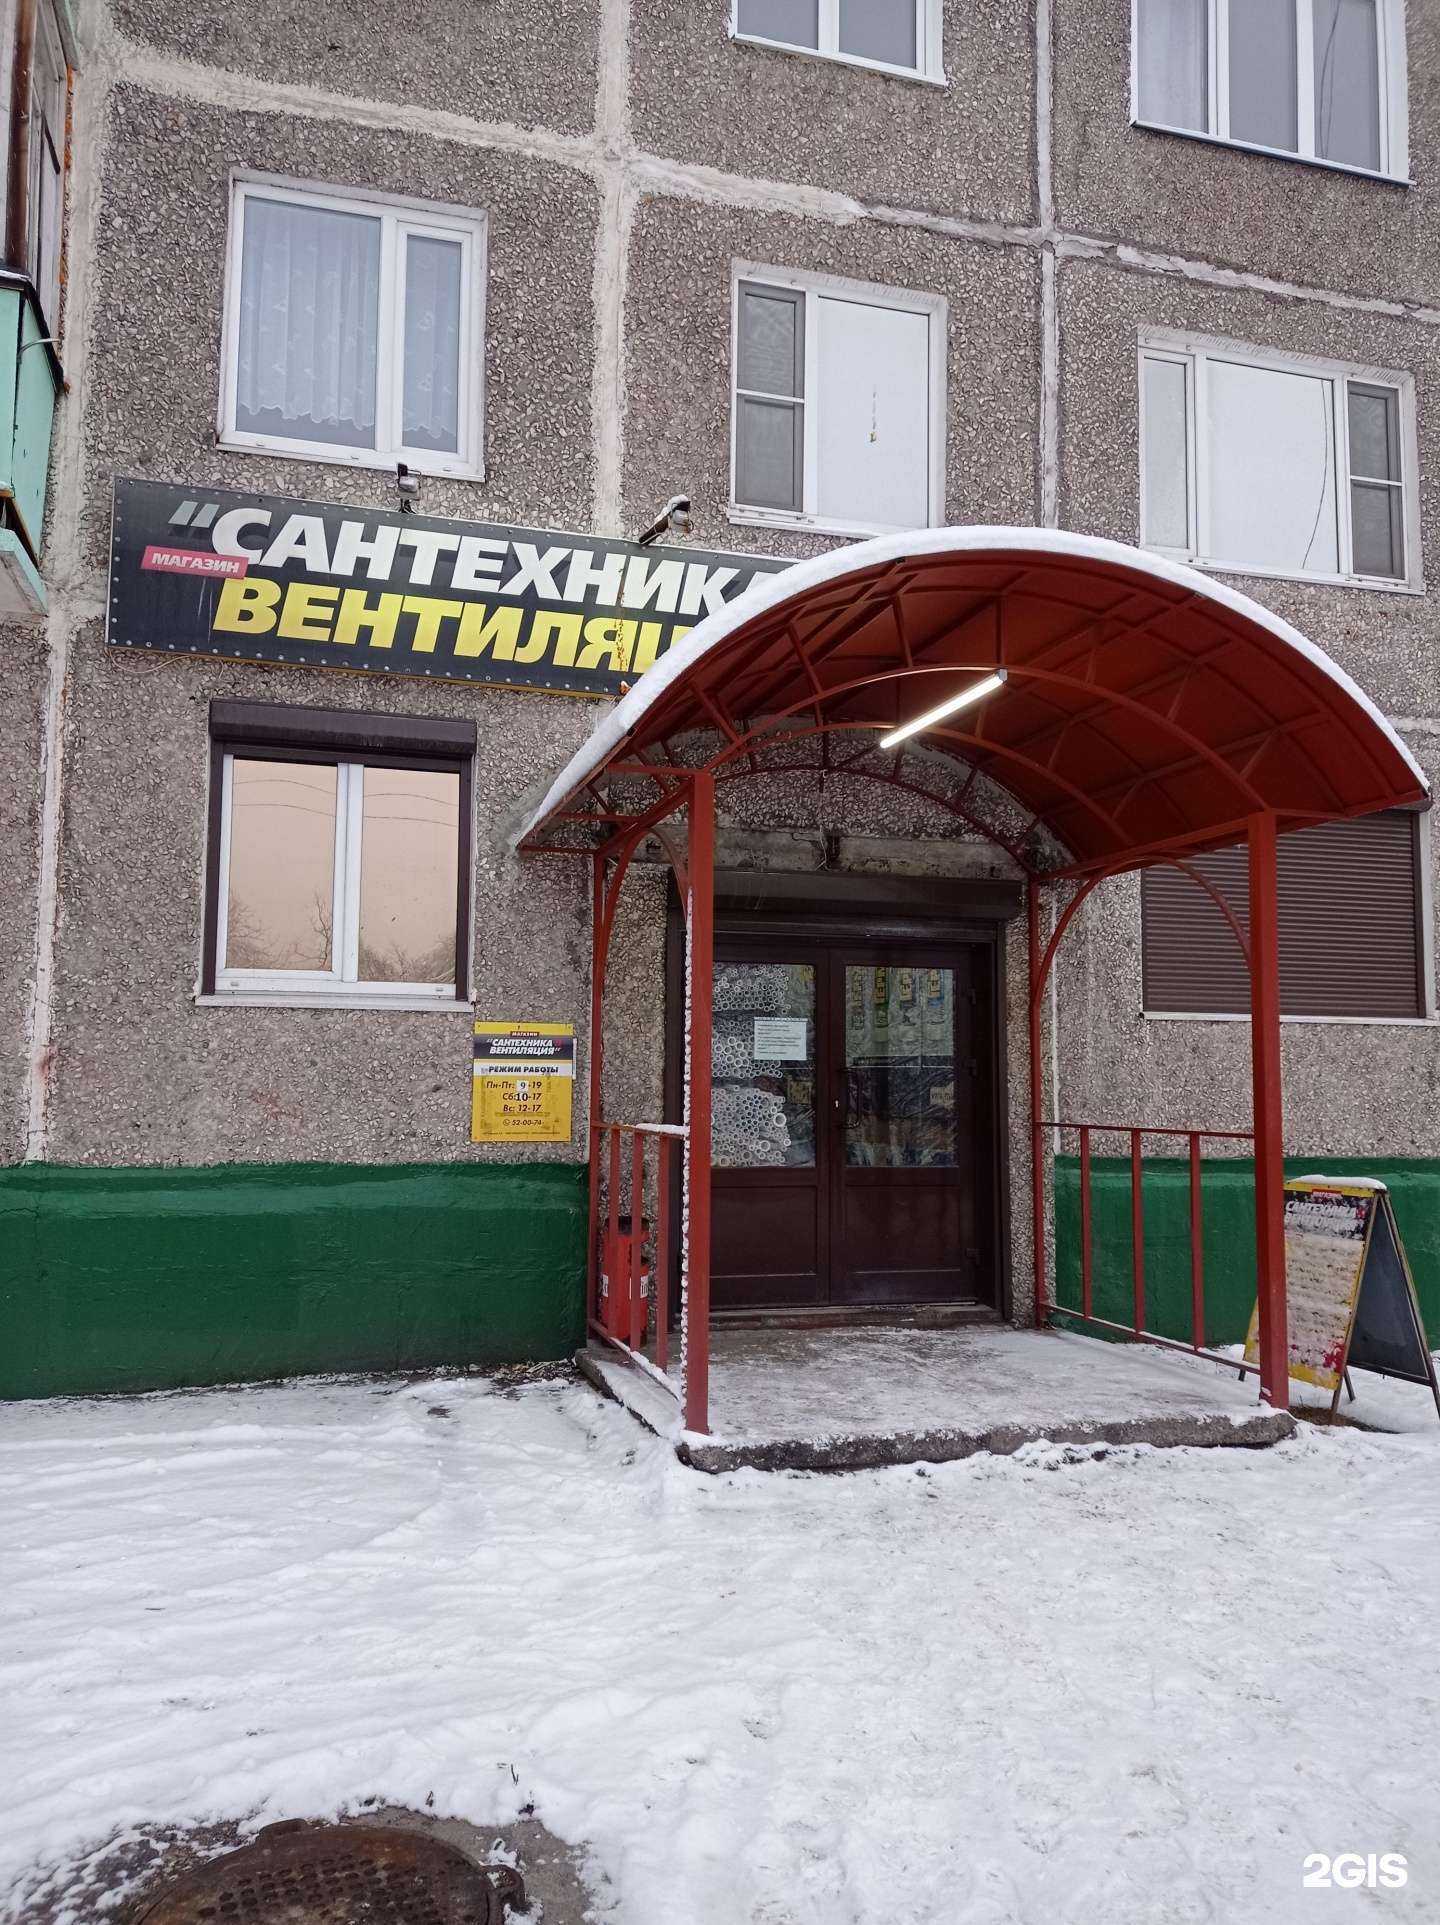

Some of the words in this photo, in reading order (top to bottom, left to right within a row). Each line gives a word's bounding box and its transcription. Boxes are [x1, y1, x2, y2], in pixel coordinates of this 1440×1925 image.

[152, 552, 241, 574] МАГАЗИН
[168, 500, 778, 617] "САНТЕХНИК
[523, 1066, 559, 1074] РАБОТЫ
